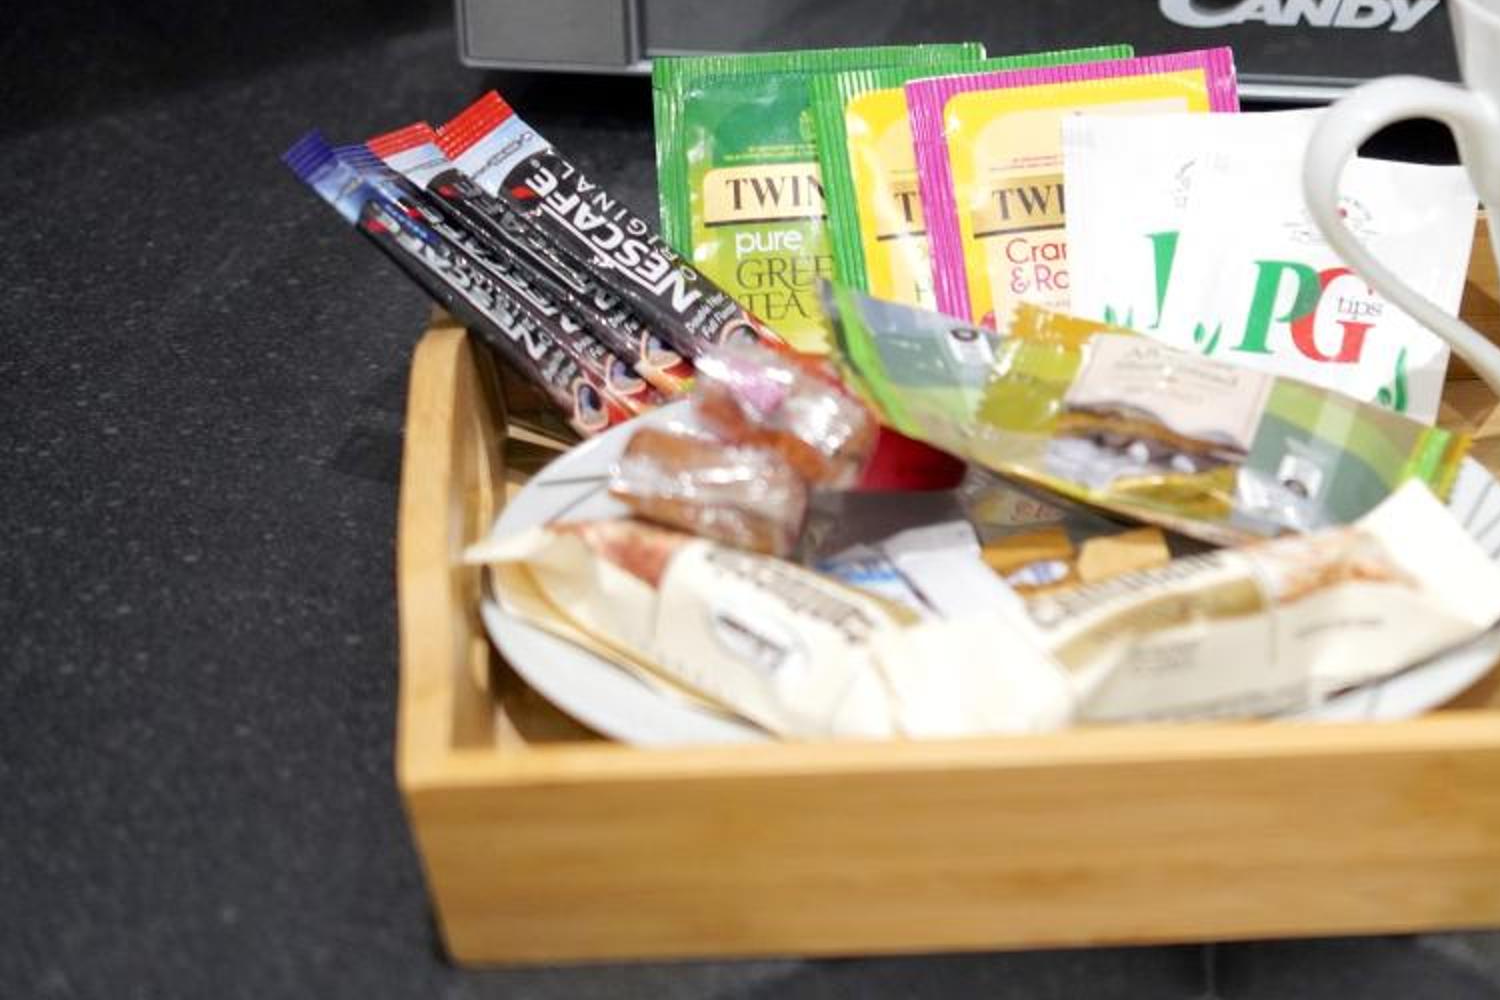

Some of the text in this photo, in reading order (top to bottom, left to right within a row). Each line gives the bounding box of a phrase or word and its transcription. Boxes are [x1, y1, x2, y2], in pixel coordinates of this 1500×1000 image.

[560, 159, 698, 281] ORIGINAL
[735, 229, 803, 260] pure
[738, 289, 810, 321] TEA
[1230, 260, 1377, 364] PG
[1337, 297, 1384, 320] tips
